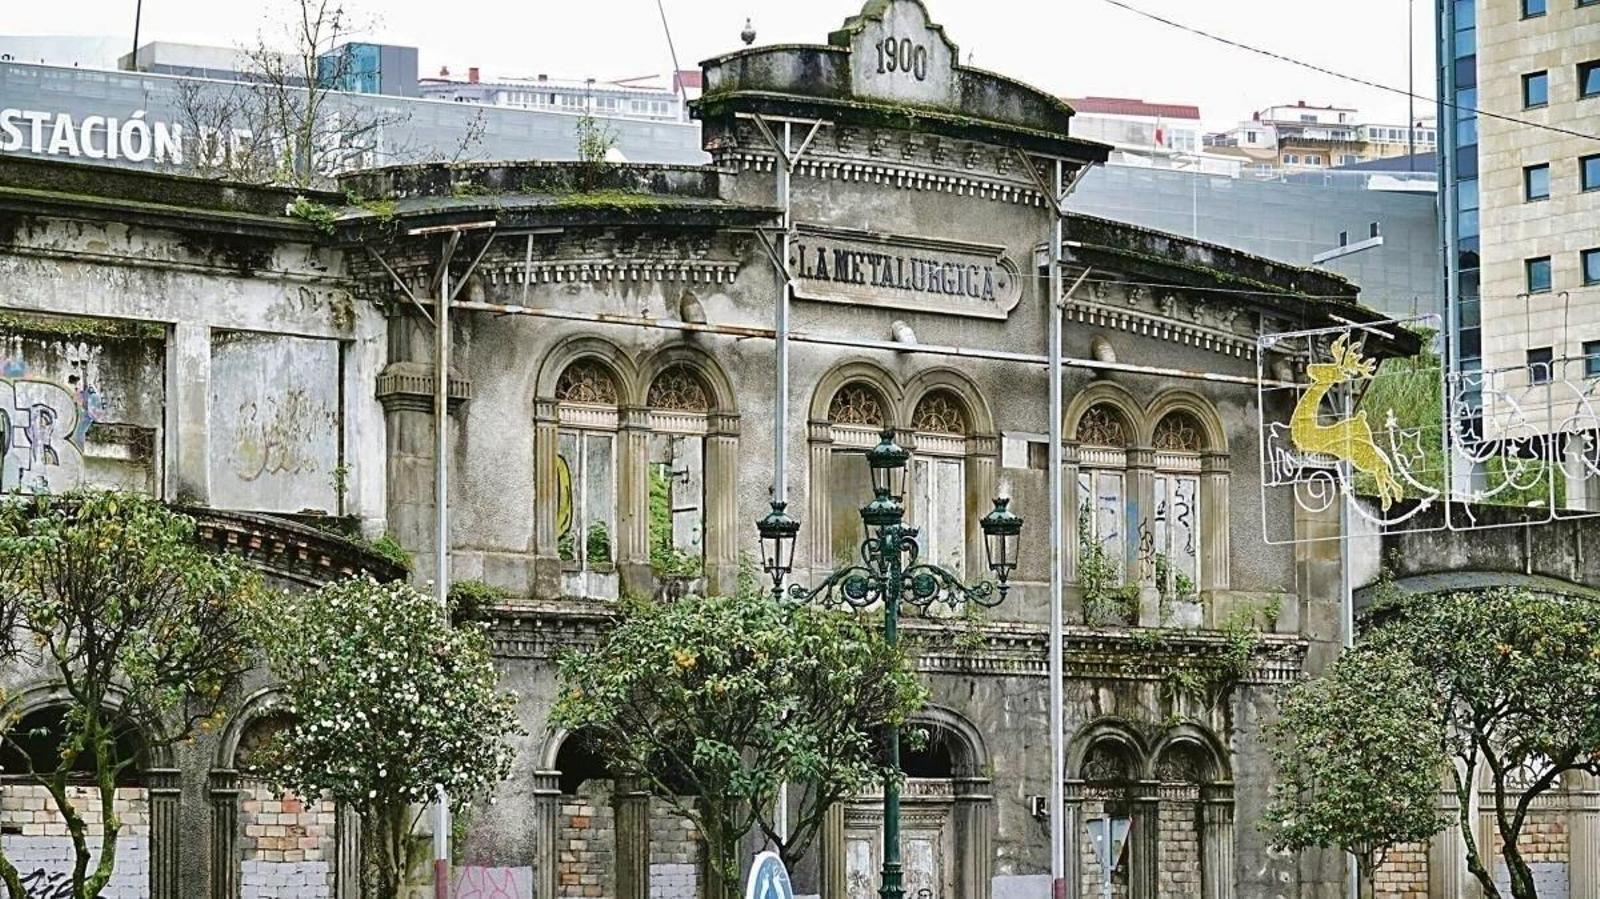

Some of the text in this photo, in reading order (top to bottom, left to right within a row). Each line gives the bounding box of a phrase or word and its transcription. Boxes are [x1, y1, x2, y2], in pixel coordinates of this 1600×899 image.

[876, 36, 928, 81] 1900
[0, 108, 184, 165] STACIÓN
[798, 245, 996, 300] LA METALURGICA
